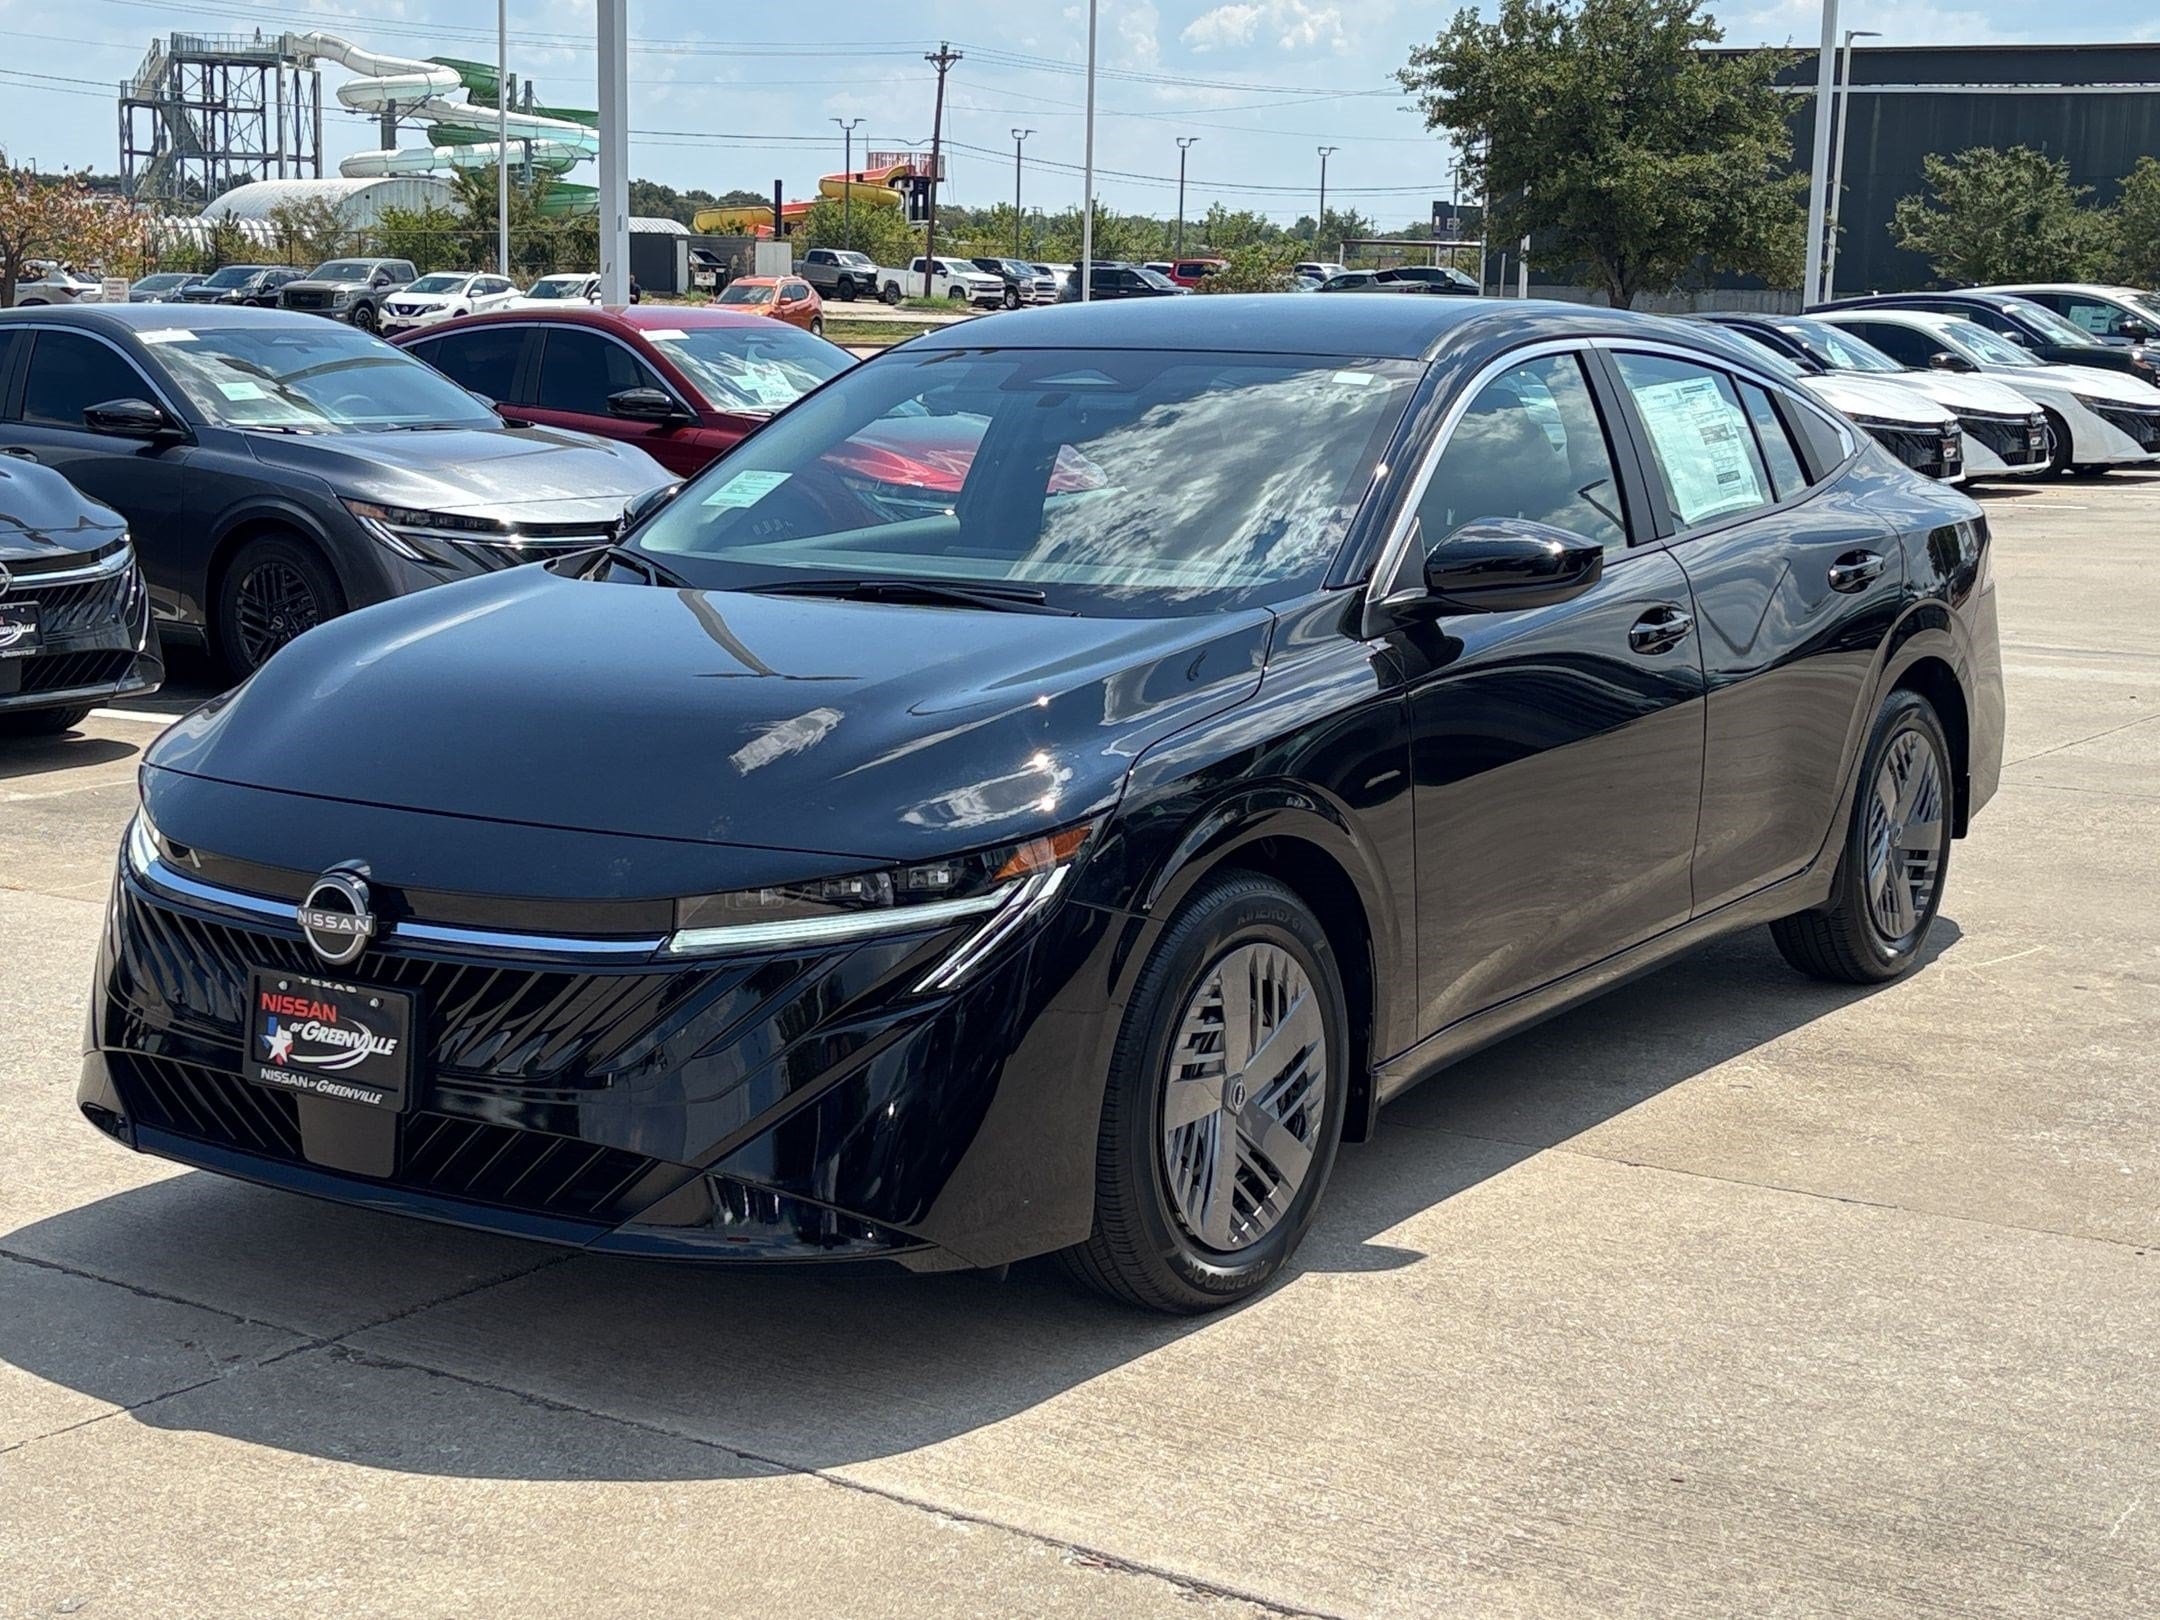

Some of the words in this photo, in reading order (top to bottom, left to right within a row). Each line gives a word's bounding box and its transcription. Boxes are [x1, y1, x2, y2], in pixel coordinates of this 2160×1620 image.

[298, 908, 370, 933] NISSAN
[298, 976, 357, 993] TEXAS
[261, 992, 337, 1023] NISSAN
[301, 1021, 398, 1056] GREENVILLE
[260, 1068, 309, 1089] NISSAN
[316, 1079, 383, 1105] GREENVILLE
